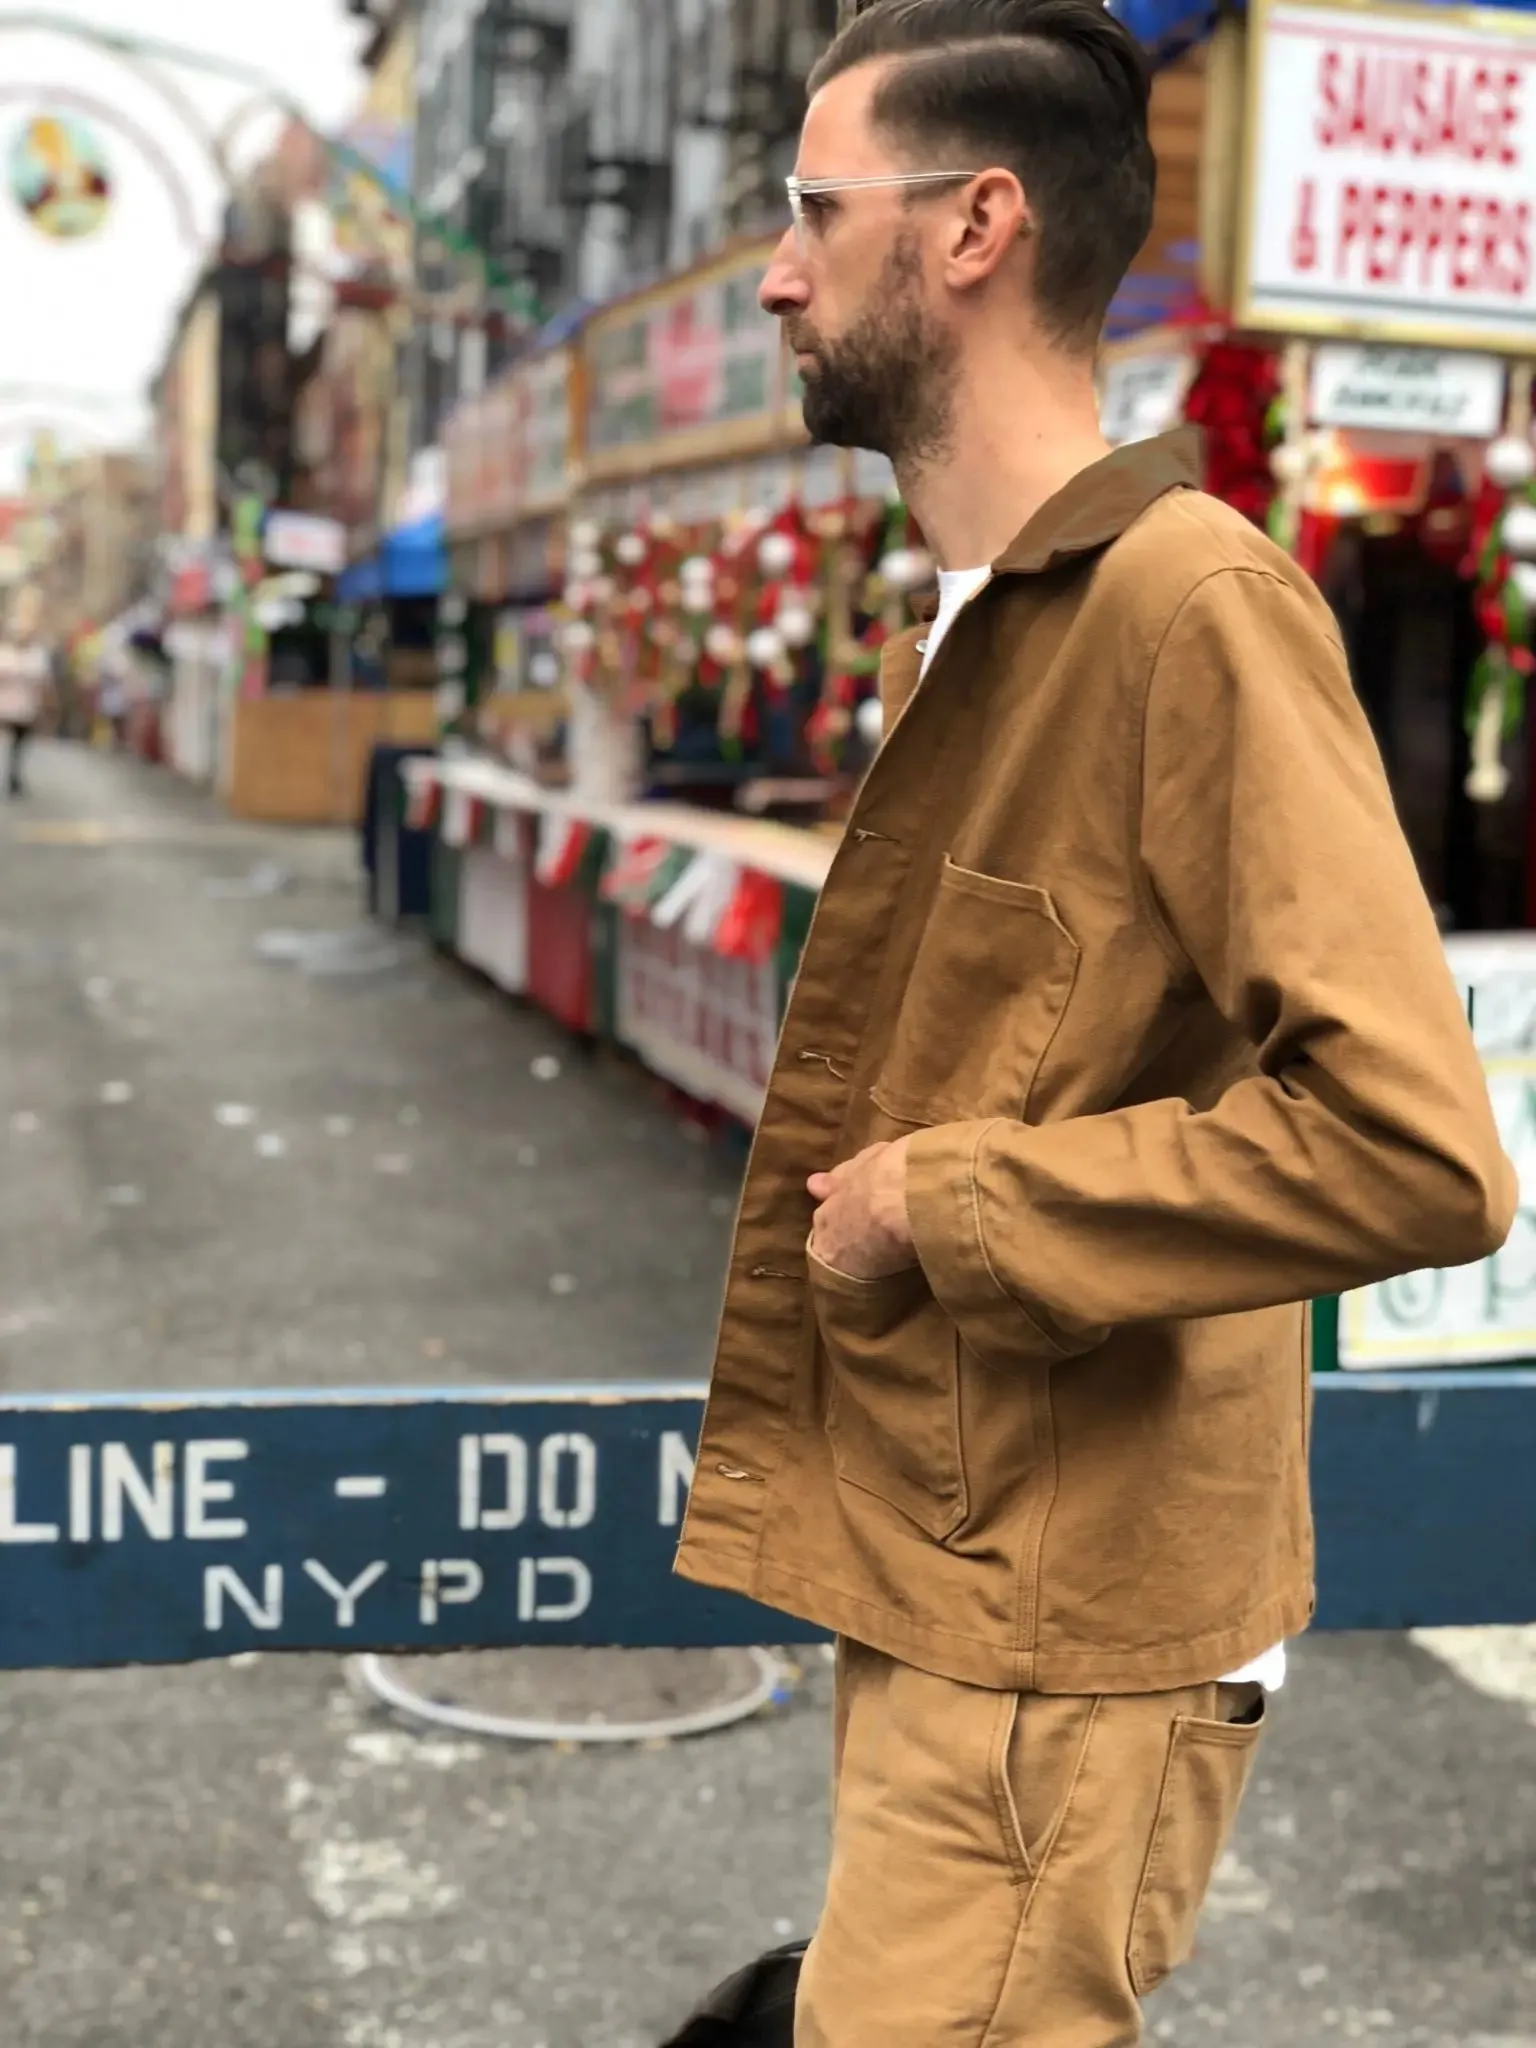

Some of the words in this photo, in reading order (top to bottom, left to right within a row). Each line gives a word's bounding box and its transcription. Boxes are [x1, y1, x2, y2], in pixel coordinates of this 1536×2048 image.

[1315, 46, 1521, 167] SAUSAGE
[1334, 178, 1533, 296] PEPPERS
[0, 1439, 248, 1543] LINE
[458, 1433, 597, 1530] DO
[204, 1556, 593, 1631] NYPD
